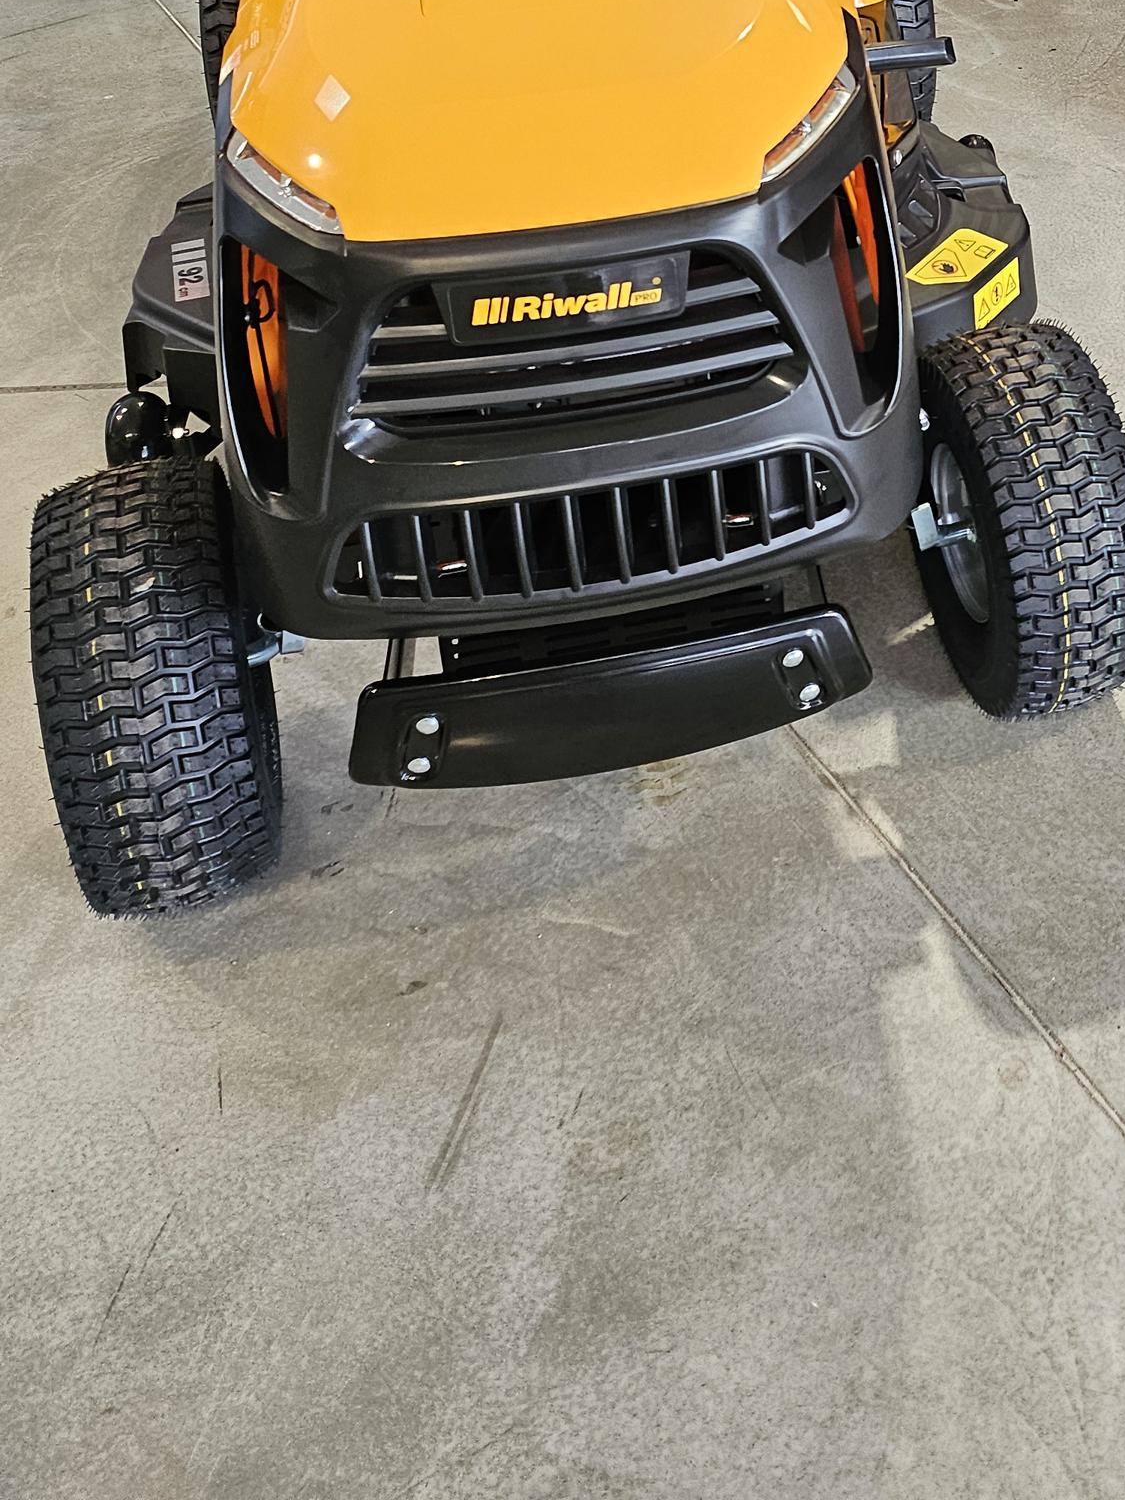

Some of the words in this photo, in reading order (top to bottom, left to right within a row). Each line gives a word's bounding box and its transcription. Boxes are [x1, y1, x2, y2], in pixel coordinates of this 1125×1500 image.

[177, 266, 204, 287] 92
[178, 287, 189, 298] cm
[511, 281, 633, 322] Riwall
[634, 291, 658, 303] PRO
